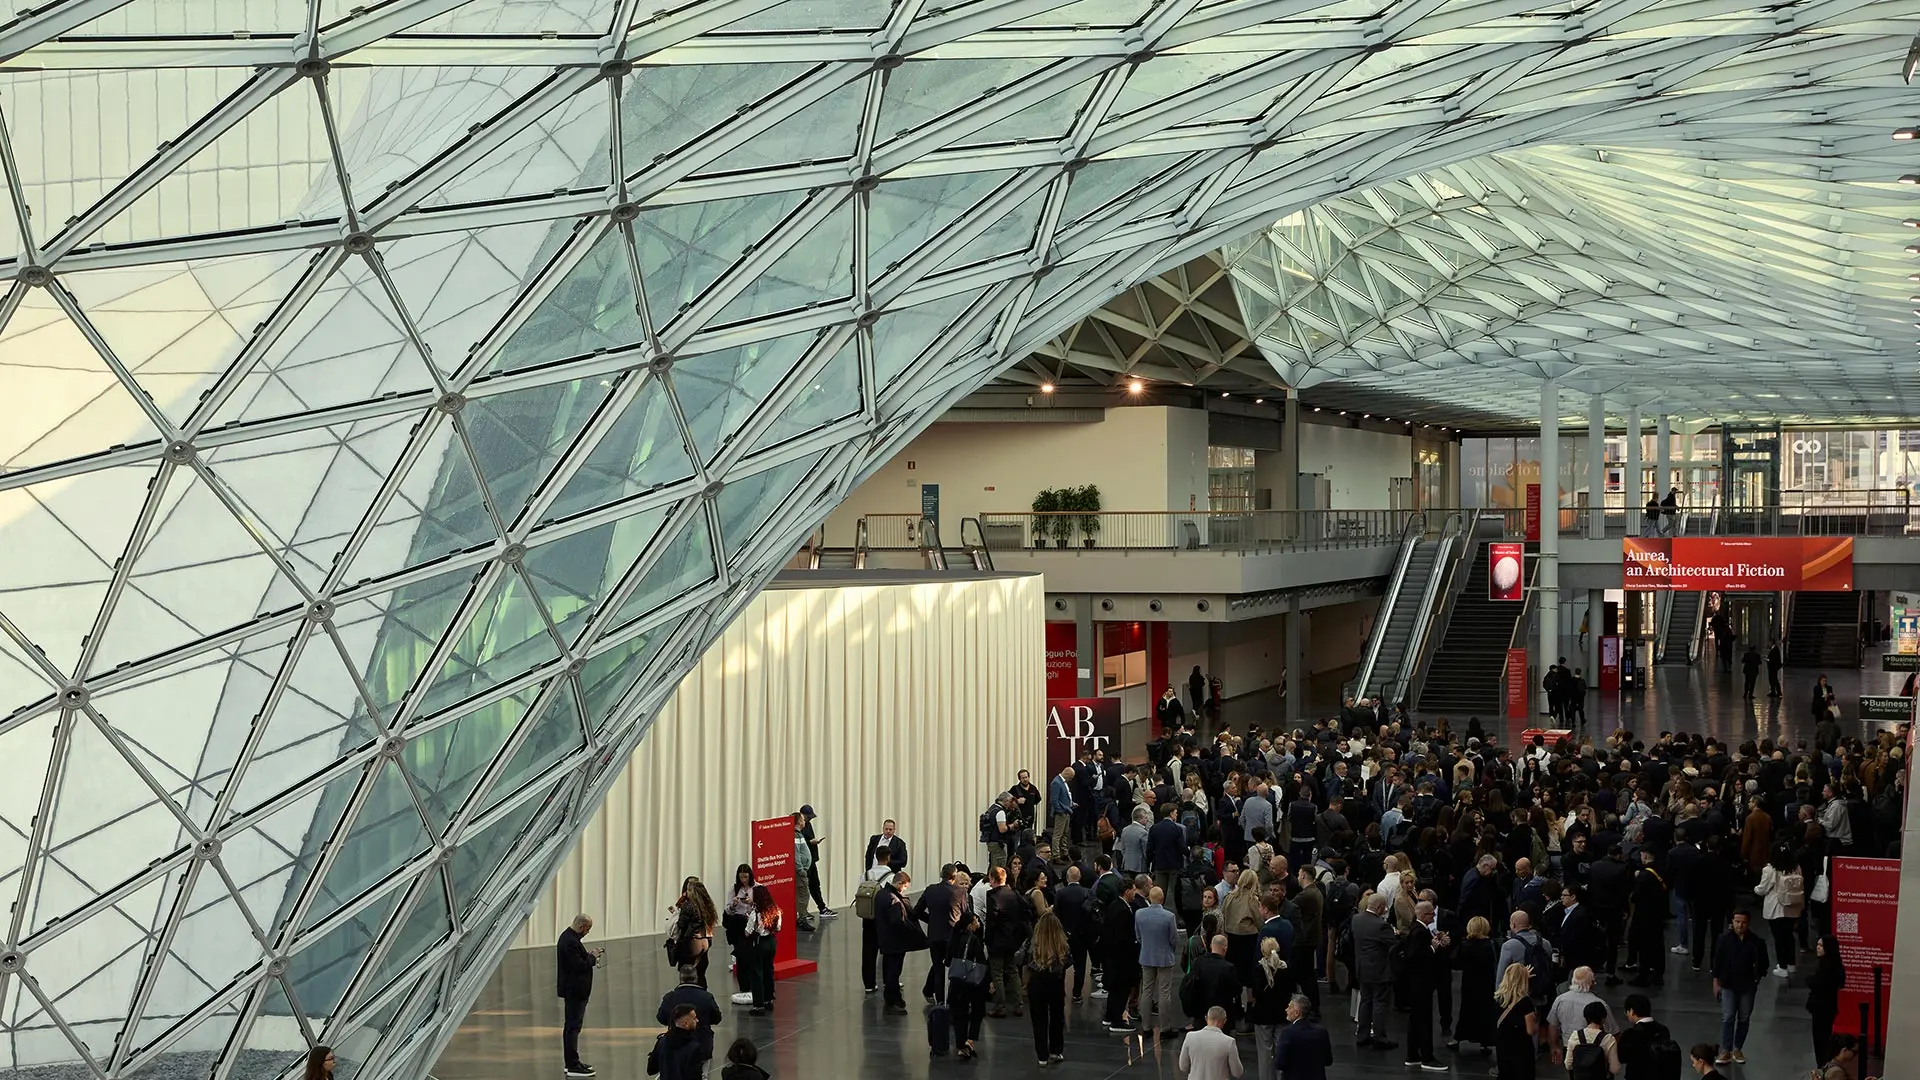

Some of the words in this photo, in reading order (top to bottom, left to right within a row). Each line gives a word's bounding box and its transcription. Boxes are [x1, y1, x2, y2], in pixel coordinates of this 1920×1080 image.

[1626, 548, 1669, 563] Aurea,
[1626, 566, 1643, 576] an
[1645, 564, 1734, 576] Architectural
[1737, 564, 1785, 577] Fiction
[1869, 699, 1908, 708] Business
